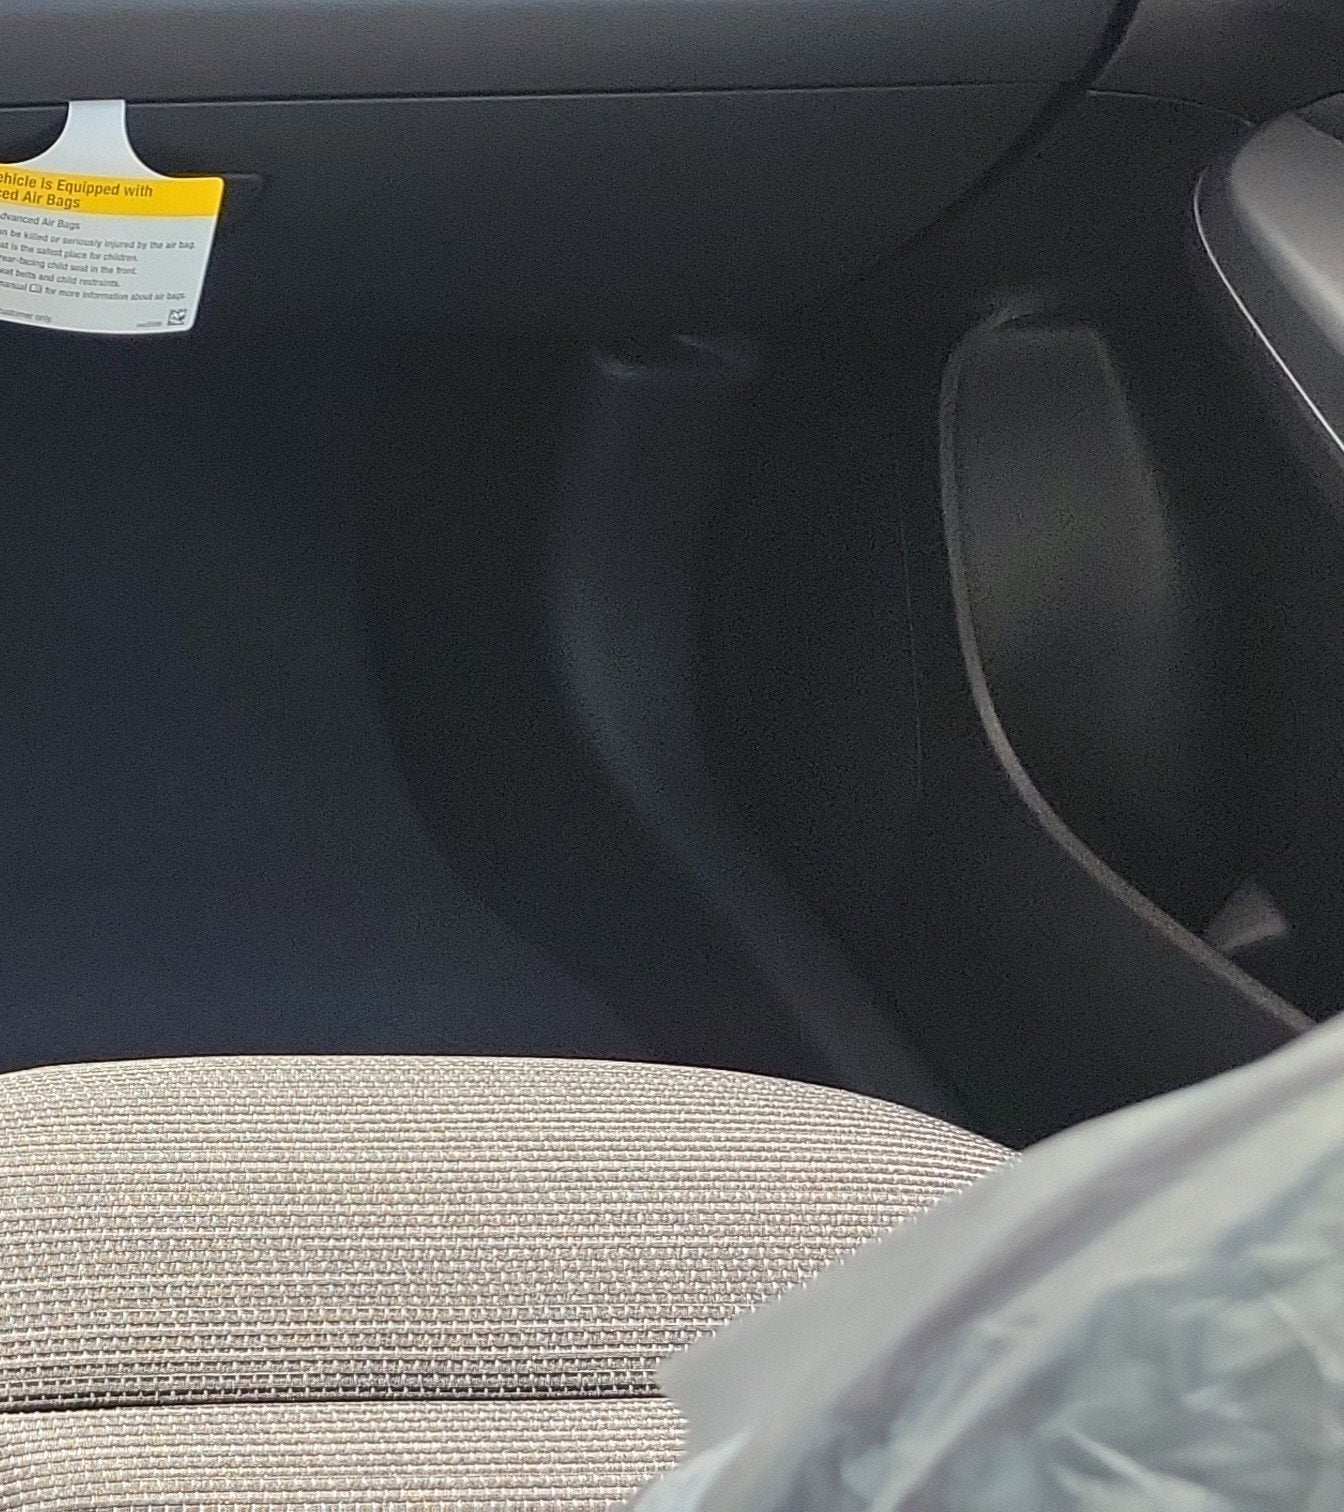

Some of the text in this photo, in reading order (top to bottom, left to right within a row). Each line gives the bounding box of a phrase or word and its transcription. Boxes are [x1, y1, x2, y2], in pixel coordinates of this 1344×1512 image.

[41, 177, 52, 190] is
[57, 179, 120, 197] Equipped
[124, 184, 153, 197] with
[22, 190, 43, 204] Air
[46, 194, 81, 210] Bags
[41, 217, 55, 227] Air
[57, 220, 81, 231] Bags
[10, 229, 21, 238] be
[24, 230, 48, 242] killed
[63, 237, 102, 248] seriously
[105, 239, 134, 249] injured
[137, 240, 147, 250] by
[150, 240, 163, 248] the
[21, 244, 34, 252] the
[64, 250, 87, 260] place
[47, 262, 68, 271] child
[38, 274, 54, 282] and
[56, 276, 77, 285] child
[58, 290, 80, 298] more
